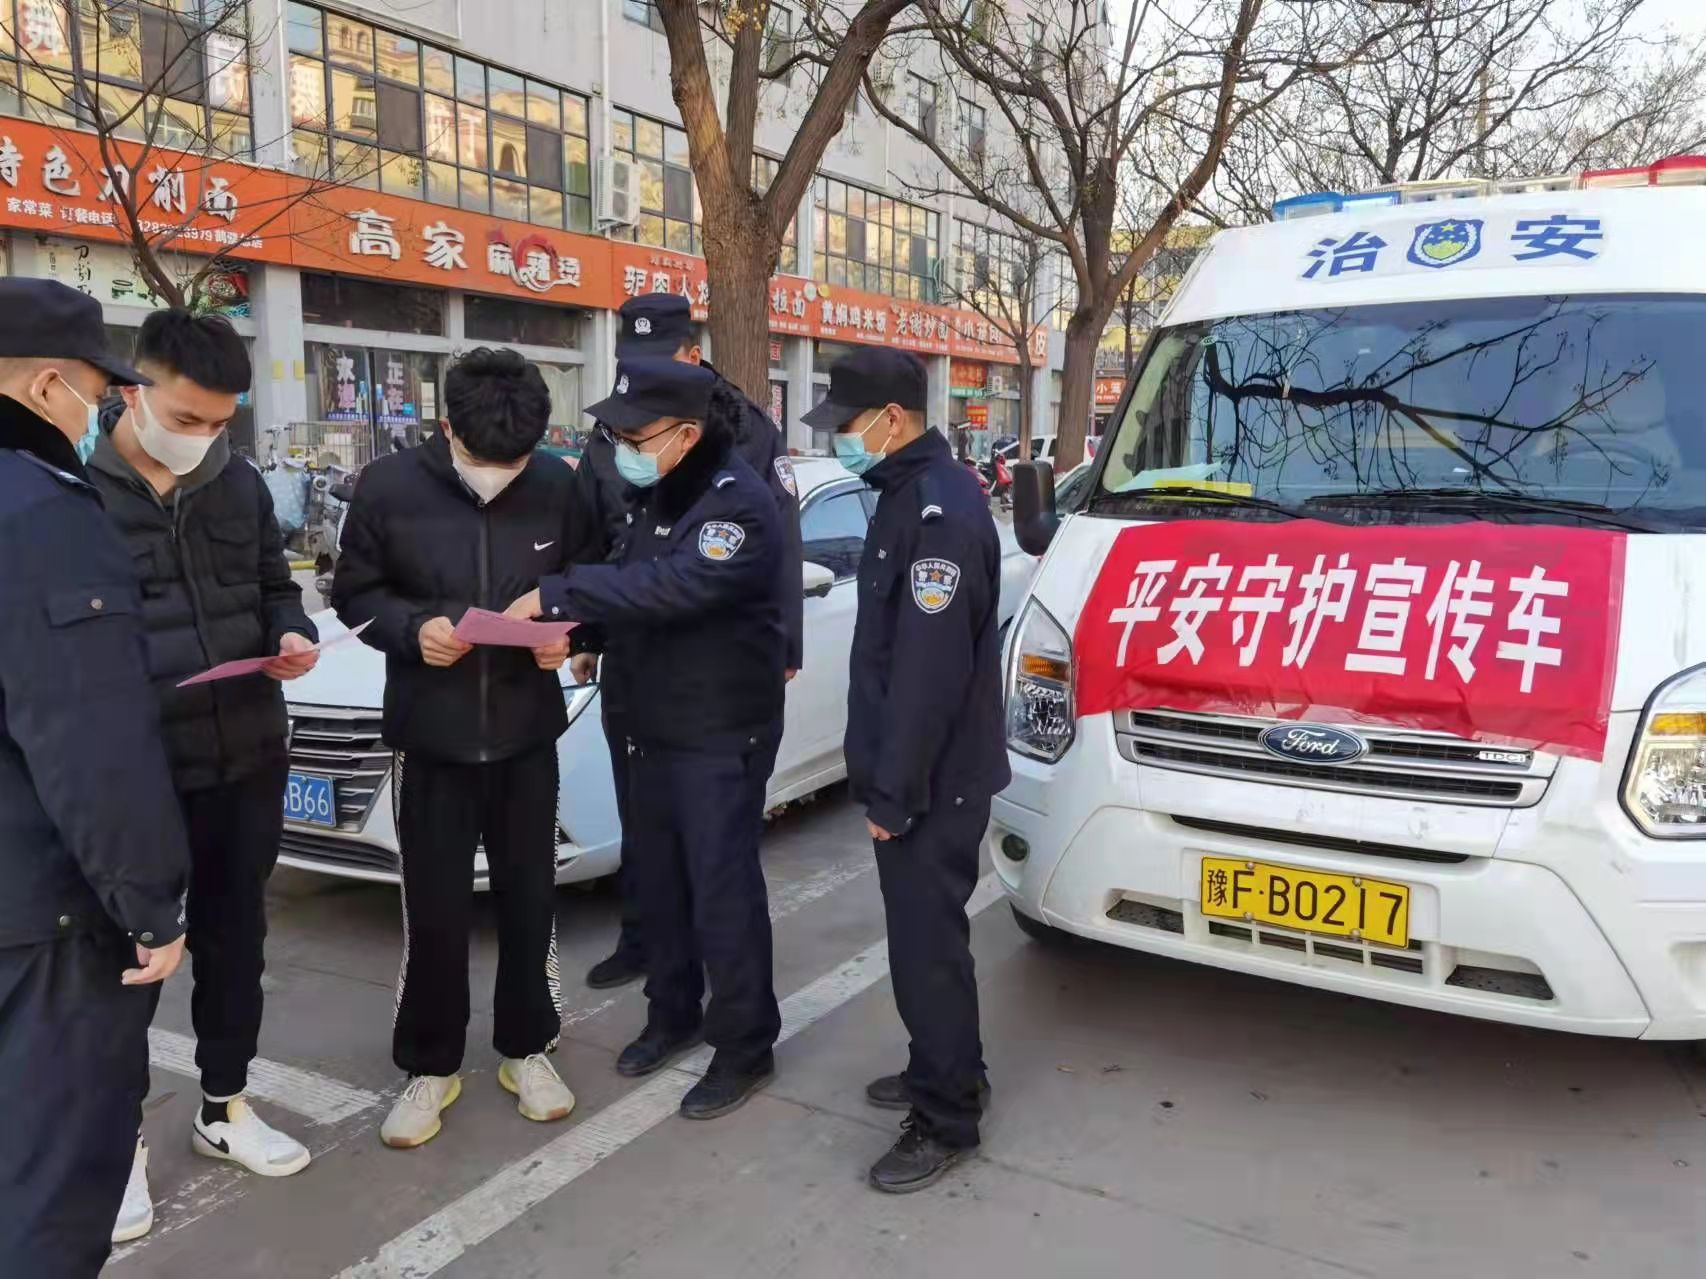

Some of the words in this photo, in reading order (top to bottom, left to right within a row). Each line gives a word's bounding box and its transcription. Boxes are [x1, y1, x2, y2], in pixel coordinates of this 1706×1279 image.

[7, 197, 53, 218] 家常菜
[1301, 214, 1603, 279] 治安
[821, 300, 887, 335] 黄焖鸡米饭
[1107, 551, 1569, 694] 平安守护宣传车
[1282, 729, 1338, 756] Ford
